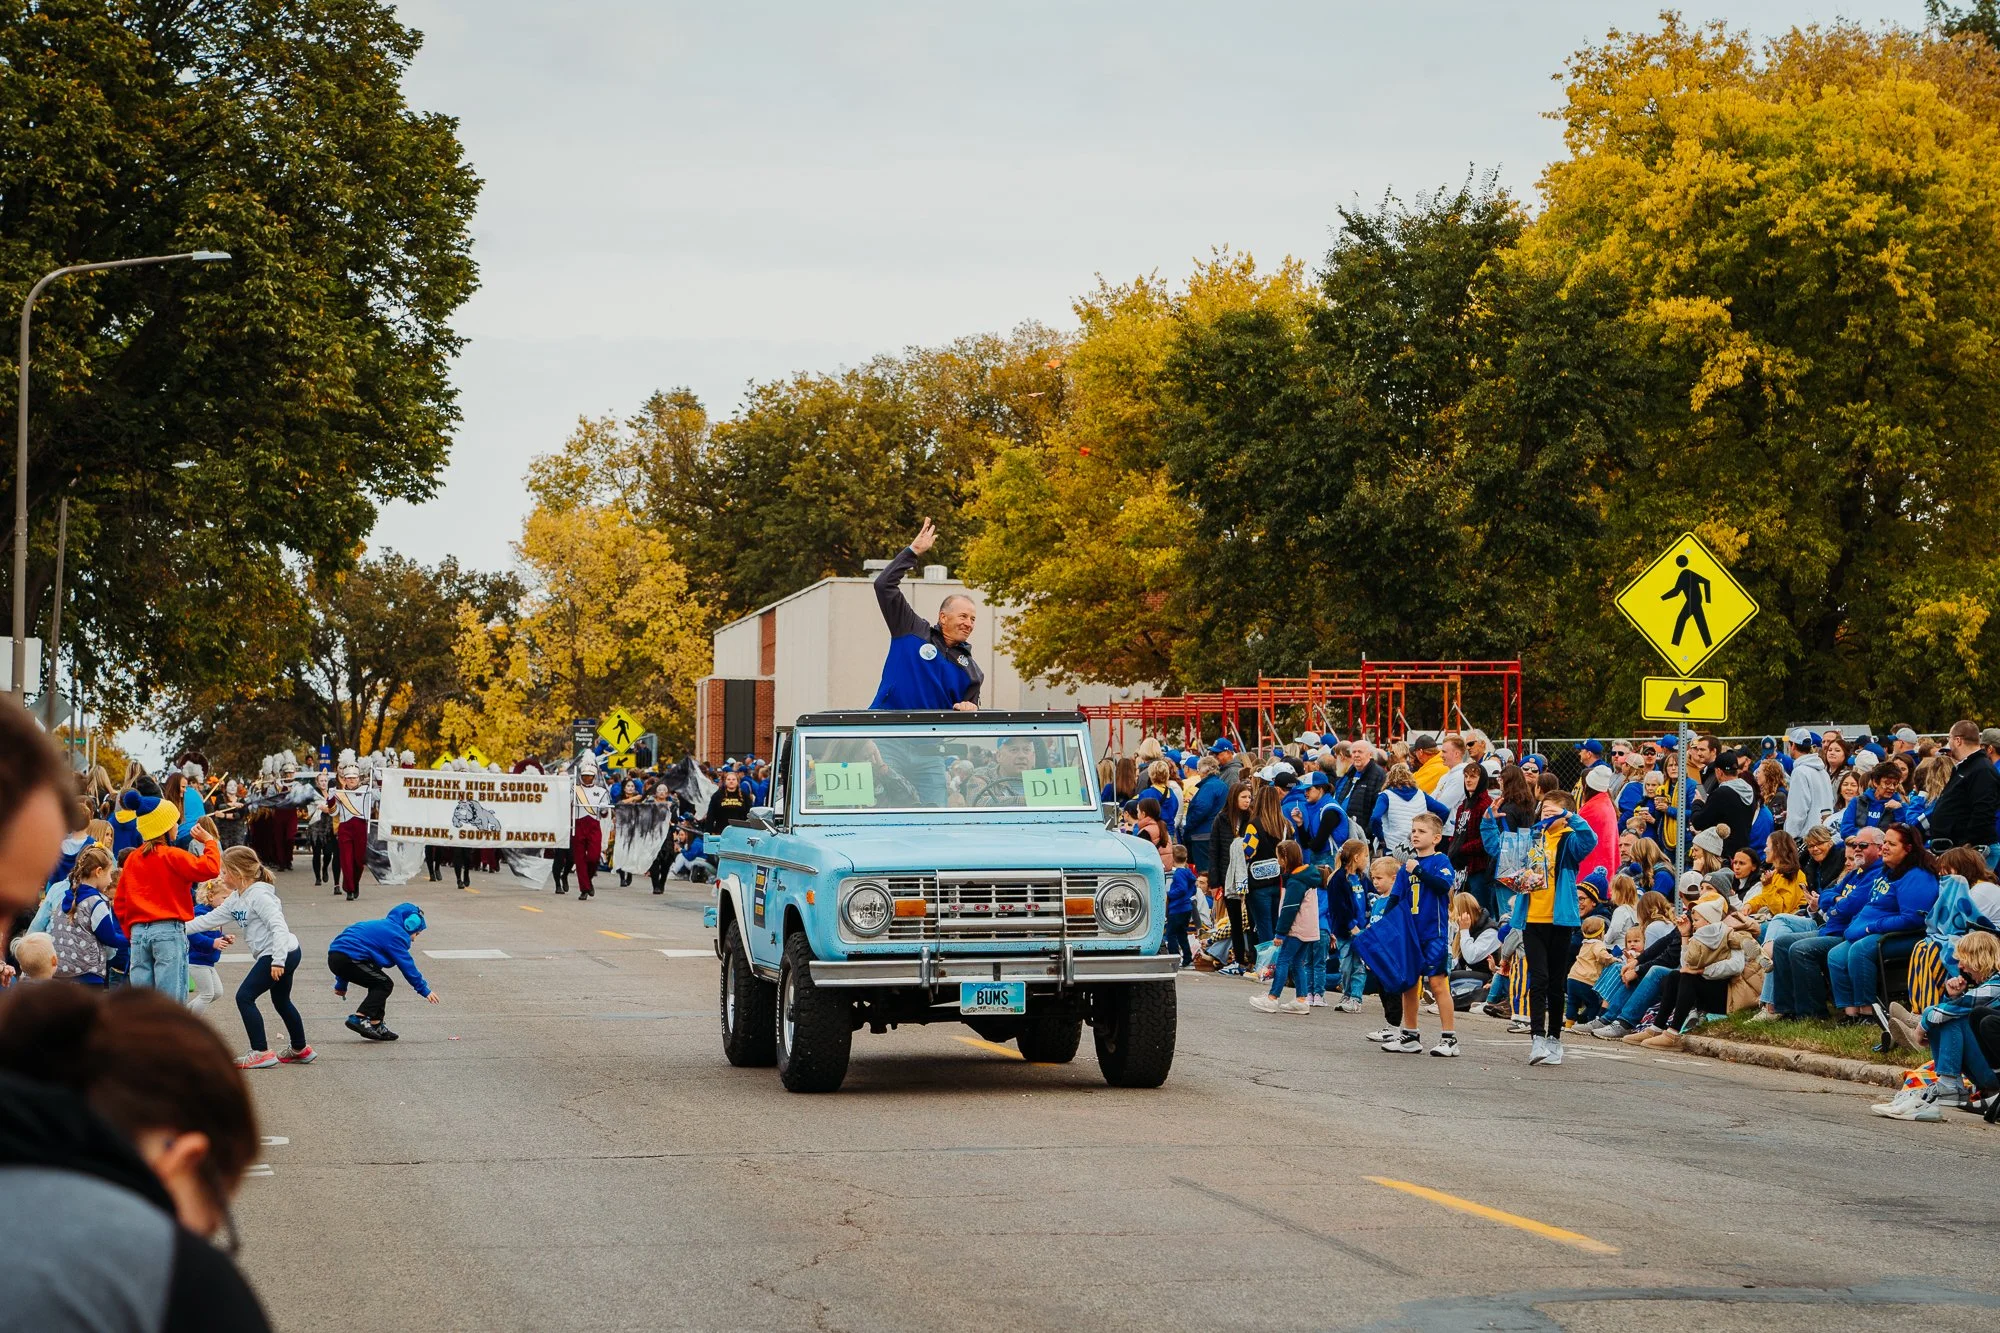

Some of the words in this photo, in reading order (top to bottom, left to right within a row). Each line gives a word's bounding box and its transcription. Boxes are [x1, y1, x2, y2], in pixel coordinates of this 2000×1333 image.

[403, 777, 461, 790] MILBANK
[465, 780, 495, 791] HIGH
[500, 782, 549, 793] SCHOOL
[824, 773, 863, 791] D11
[1031, 778, 1072, 797] D11
[408, 788, 474, 801] MARCHING
[478, 792, 543, 803] BULLDOGS
[390, 825, 454, 841] MILBANK,
[458, 829, 501, 841] SOUTH
[505, 831, 557, 842] DAKOTA
[976, 990, 1009, 1005] BUMS
